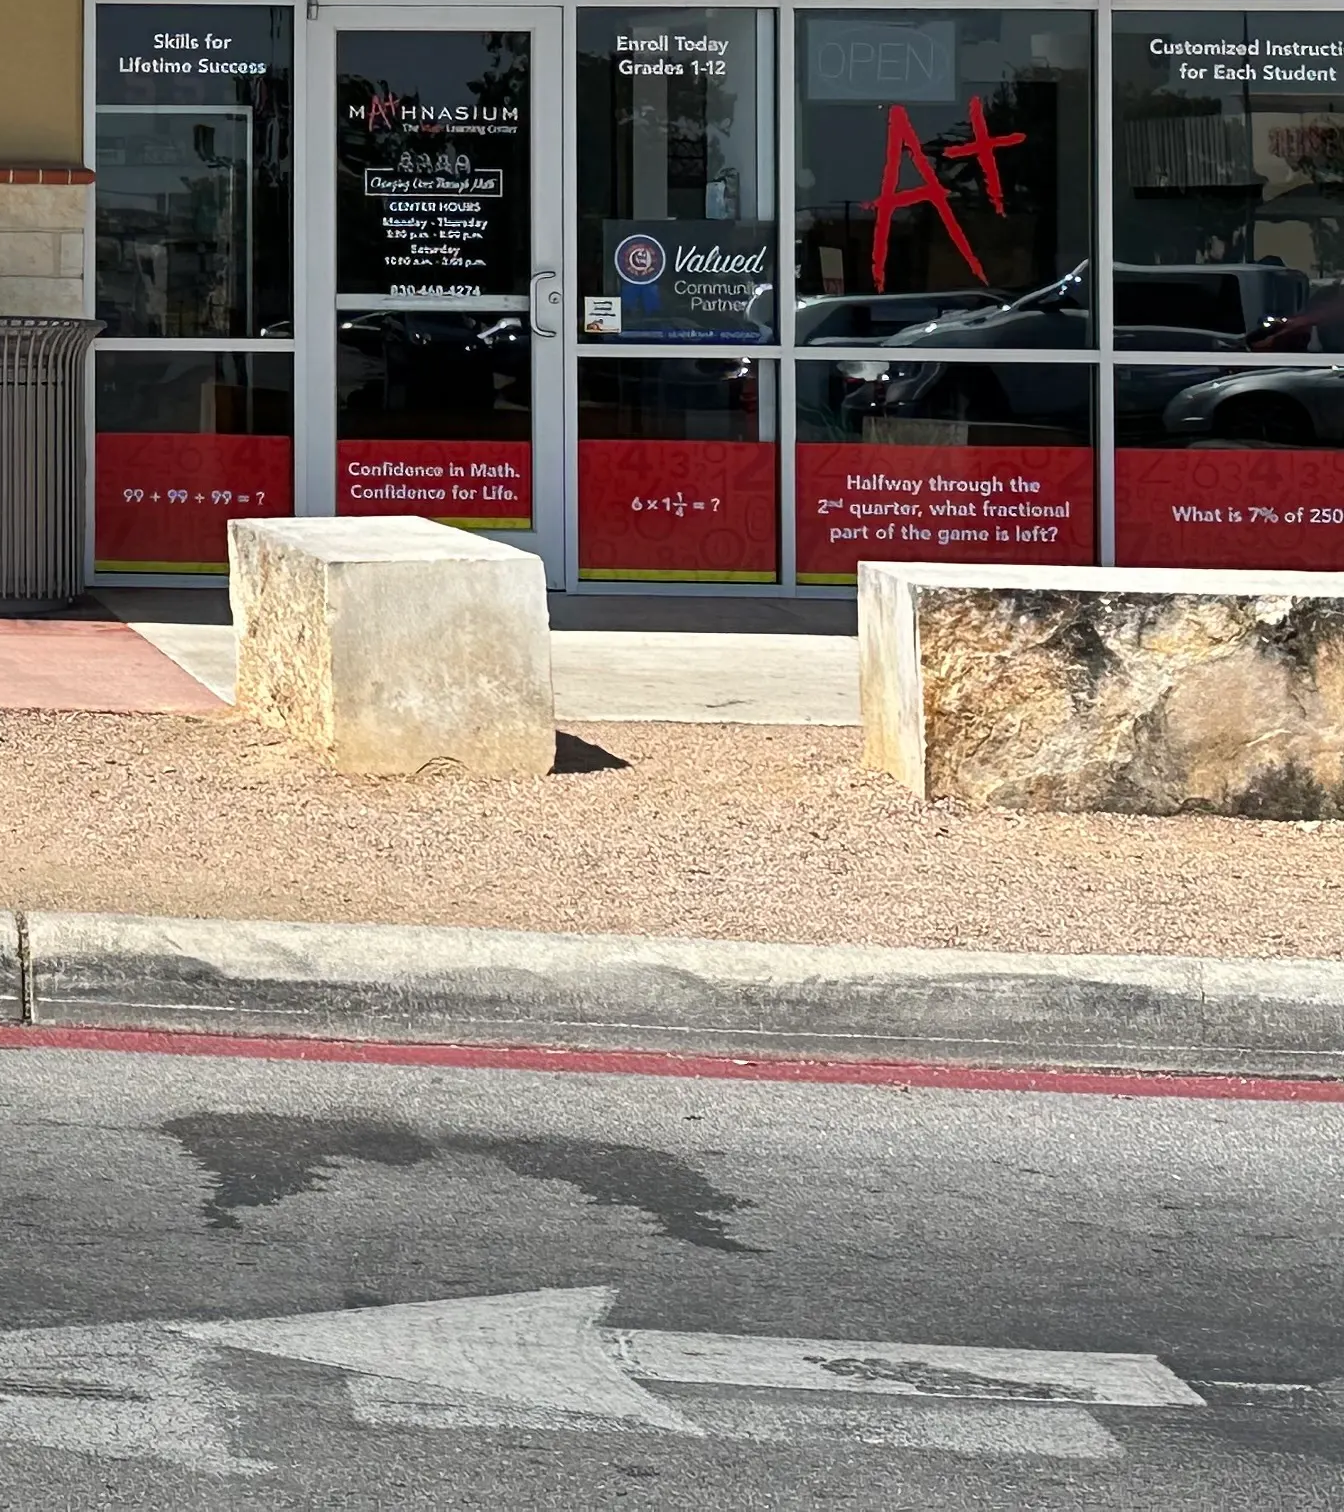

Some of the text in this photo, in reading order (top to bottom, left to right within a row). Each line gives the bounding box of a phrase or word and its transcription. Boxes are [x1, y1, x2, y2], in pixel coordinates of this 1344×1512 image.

[154, 33, 232, 49] Skills for
[617, 35, 729, 55] Enroll Today
[1150, 39, 1344, 56] Customized Instructi
[119, 57, 267, 74] Lifetime Success
[619, 59, 726, 75] Grades 1-12
[818, 42, 935, 82] OPEN
[1179, 63, 1337, 81] for Each Student
[389, 202, 481, 212] CENTER HOURS
[674, 245, 767, 274] Valued
[348, 462, 520, 478] Confidence in Math.
[350, 484, 518, 501] Confidence for Life.
[847, 474, 1041, 497] Halfway through the
[123, 489, 144, 502] 99
[167, 489, 188, 503] 99
[211, 490, 232, 504] 99
[849, 501, 923, 519] quarter,
[928, 500, 977, 517] what
[982, 500, 1071, 519] fractional
[1172, 505, 1344, 524] What is 7% of 250
[830, 523, 1059, 545] part of the game is left?
